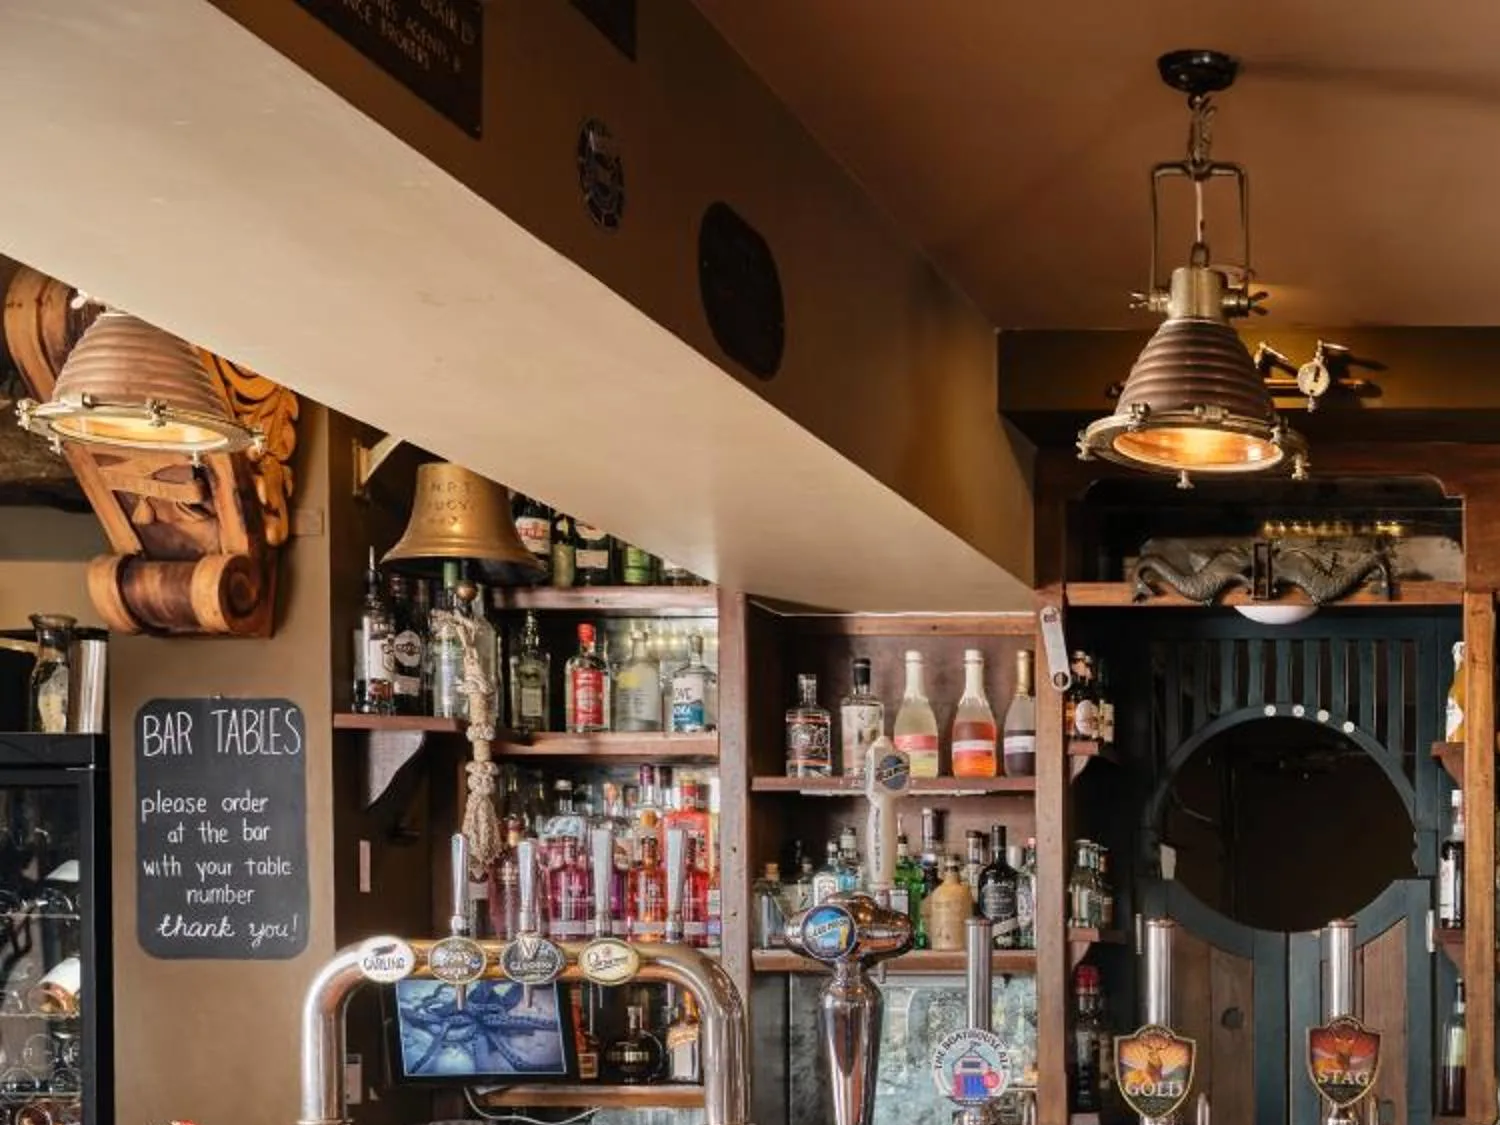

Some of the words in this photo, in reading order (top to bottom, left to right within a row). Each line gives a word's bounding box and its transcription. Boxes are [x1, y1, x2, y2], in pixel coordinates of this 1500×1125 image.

[143, 711, 193, 757] BAR
[210, 707, 301, 756] TABLES
[141, 789, 207, 823] please
[221, 790, 269, 813] order
[166, 821, 187, 844] at
[197, 820, 230, 844] the
[242, 818, 271, 842] bar
[143, 853, 182, 877] with
[195, 860, 233, 882] your
[244, 855, 293, 877] table
[186, 883, 256, 906] number
[157, 913, 236, 939] thank
[248, 912, 299, 949] you!
[1125, 1081, 1184, 1098] GOLD
[1317, 1071, 1370, 1087] STAG
